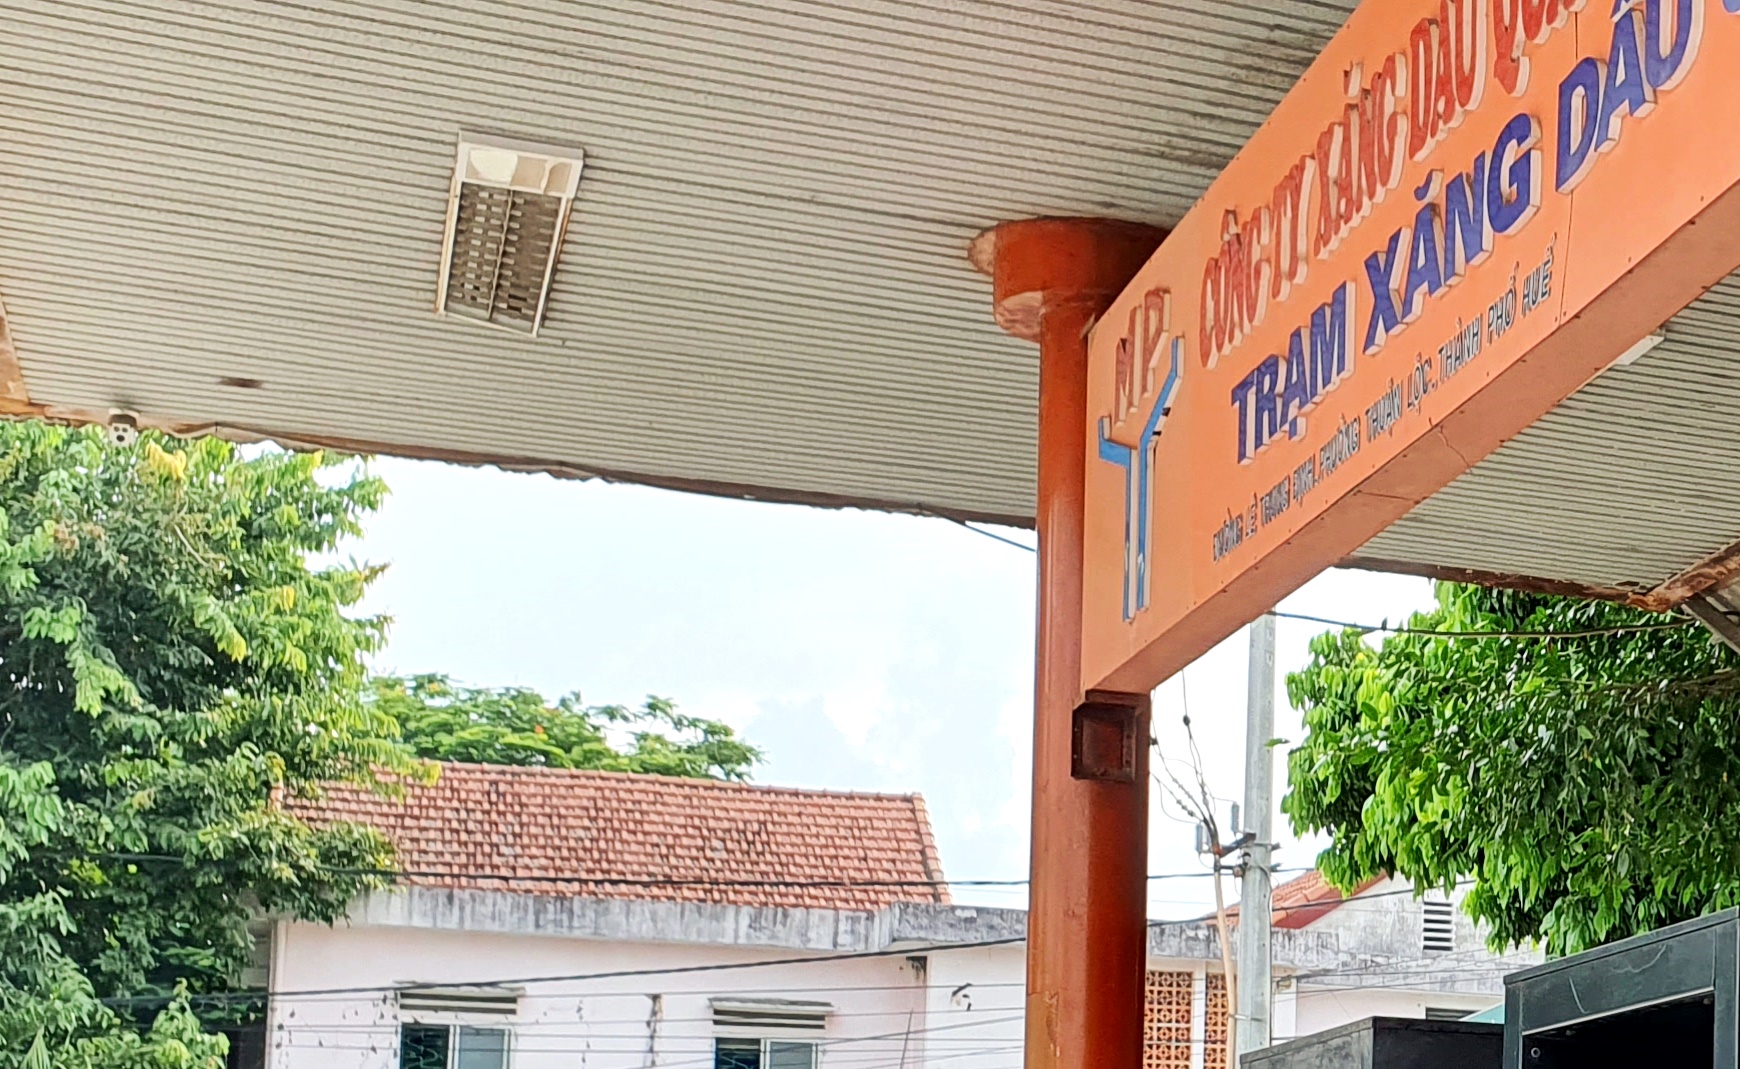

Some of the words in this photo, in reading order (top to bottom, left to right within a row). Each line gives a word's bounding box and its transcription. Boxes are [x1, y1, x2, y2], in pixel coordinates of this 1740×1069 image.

[1200, 208, 1271, 370] CÔNG
[1271, 153, 1316, 302] TY
[1231, 280, 1357, 466] TRẠM
[1361, 112, 1542, 356] XĂNG
[1438, 316, 1483, 384] THÀNH
[1485, 261, 1520, 345] PHỐ
[1520, 232, 1559, 319] HUẾ
